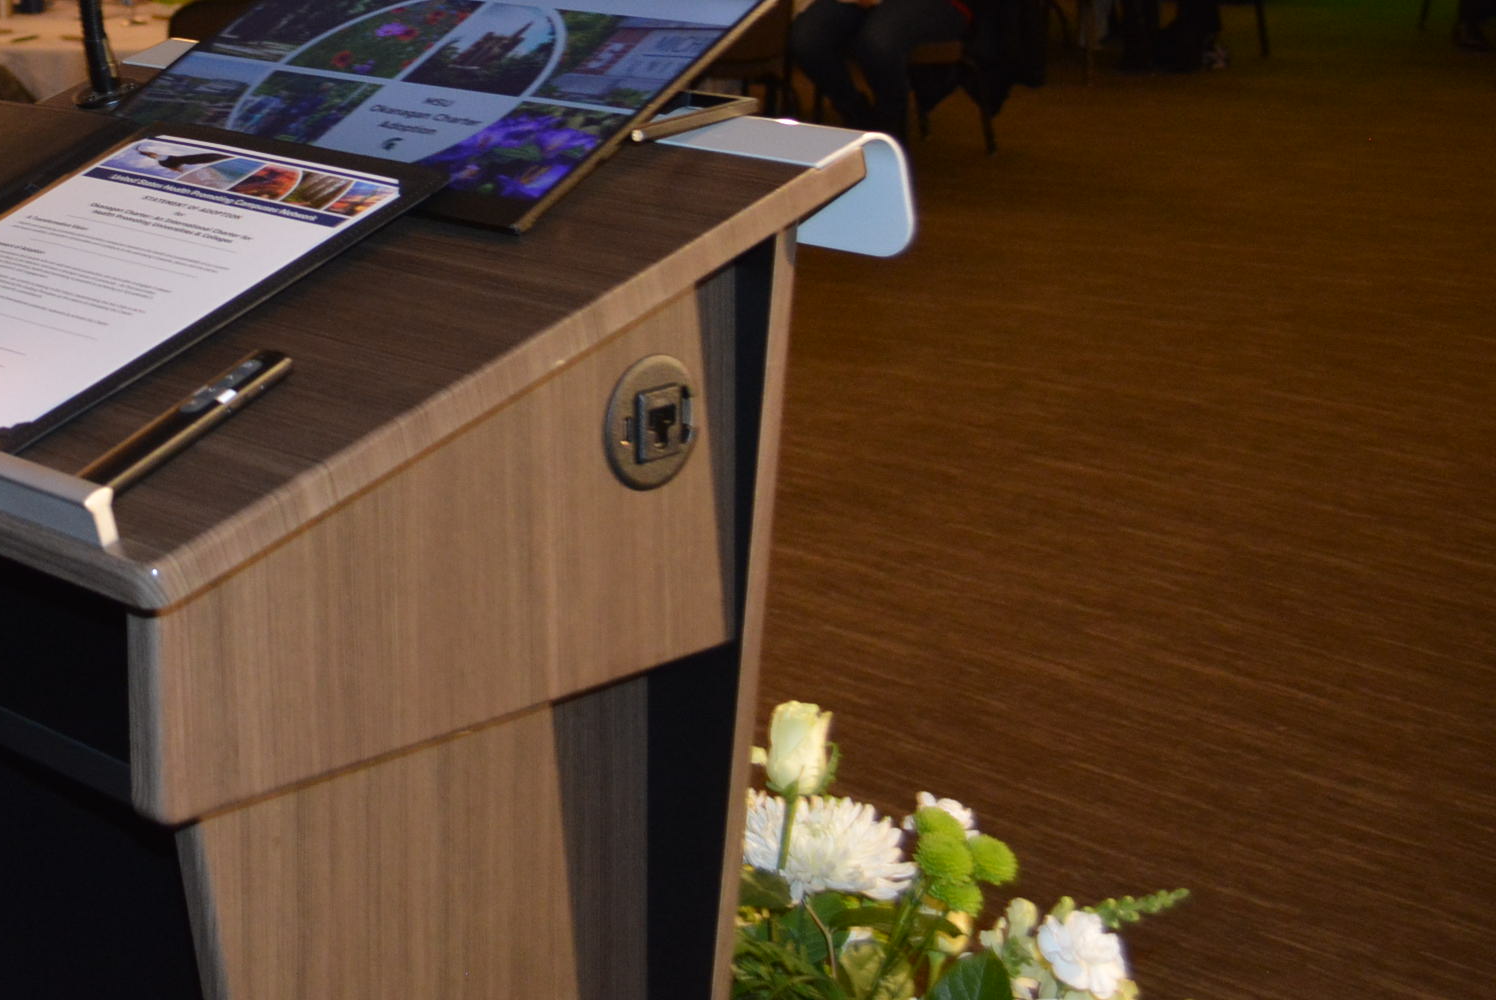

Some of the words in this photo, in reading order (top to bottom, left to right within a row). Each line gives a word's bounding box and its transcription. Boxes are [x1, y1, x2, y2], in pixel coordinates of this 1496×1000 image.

[370, 104, 431, 119] Okanagan
[432, 113, 482, 126] Charter
[423, 97, 454, 107] MSU
[109, 173, 139, 185] United
[138, 178, 163, 190] States
[162, 184, 191, 196] Health
[190, 190, 235, 206] Promoting
[234, 199, 279, 214] Campuses
[278, 208, 318, 222] Network
[142, 195, 188, 208] STATEMENT
[198, 207, 243, 220] ADOPTION
[90, 202, 124, 213] Okanagan
[164, 218, 212, 232] International
[212, 227, 241, 238] Charter
[91, 210, 115, 218] Health
[115, 214, 152, 227] Promoting
[151, 222, 194, 236] Universities
[201, 233, 233, 244] Colleges
